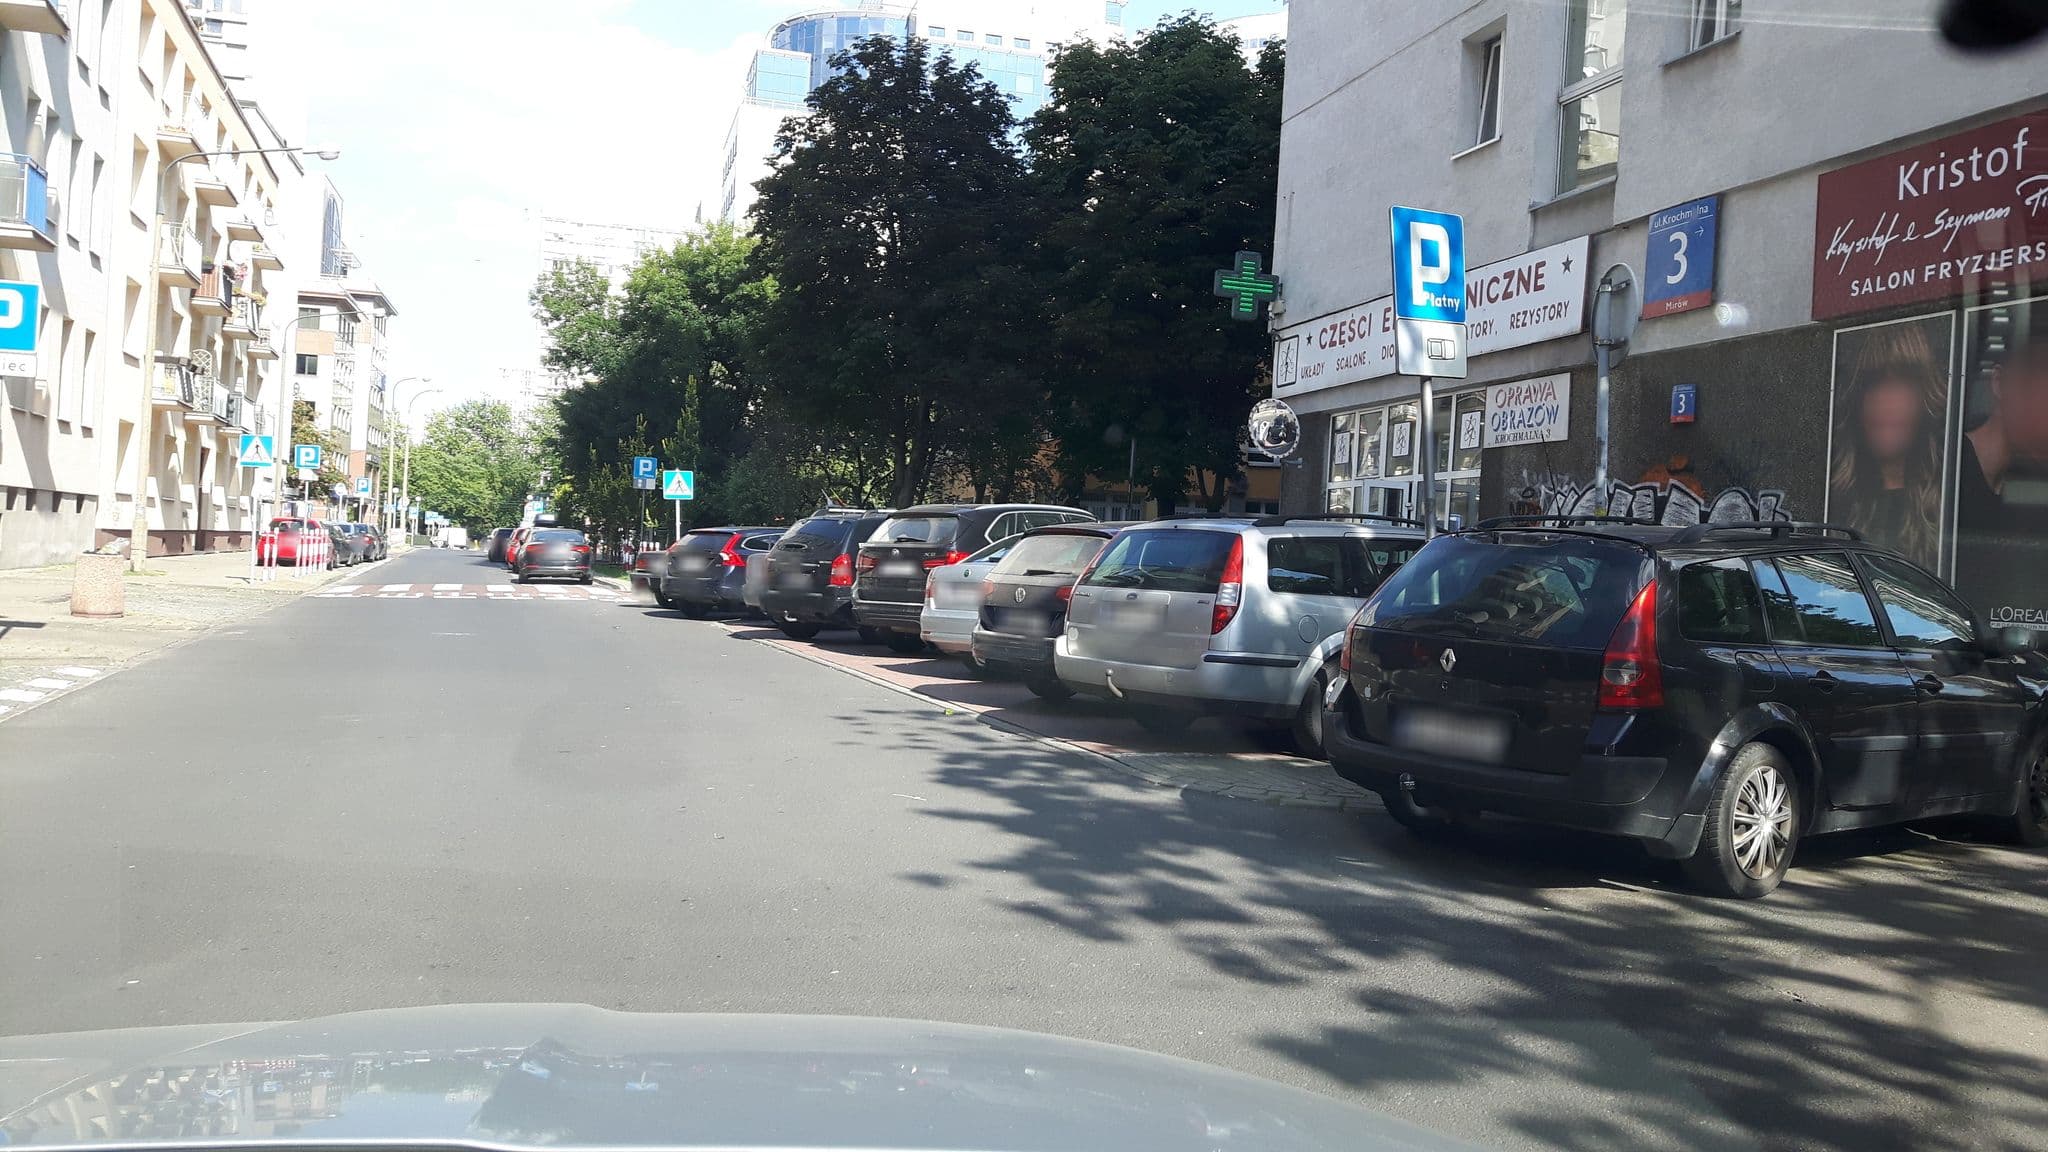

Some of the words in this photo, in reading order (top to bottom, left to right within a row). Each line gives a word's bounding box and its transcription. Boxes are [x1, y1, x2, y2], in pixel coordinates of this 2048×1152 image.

[1898, 127, 2029, 201] Kristof
[1409, 221, 1451, 307] P
[1666, 231, 1688, 285] 3
[1850, 270, 1916, 298] SALON
[1318, 312, 1373, 350] CZĘŚCI
[1510, 300, 1570, 331] REZYSTORY
[1495, 380, 1557, 409] OPRAWA
[1677, 393, 1686, 414] 3
[1491, 403, 1559, 432] OBRAZÓW
